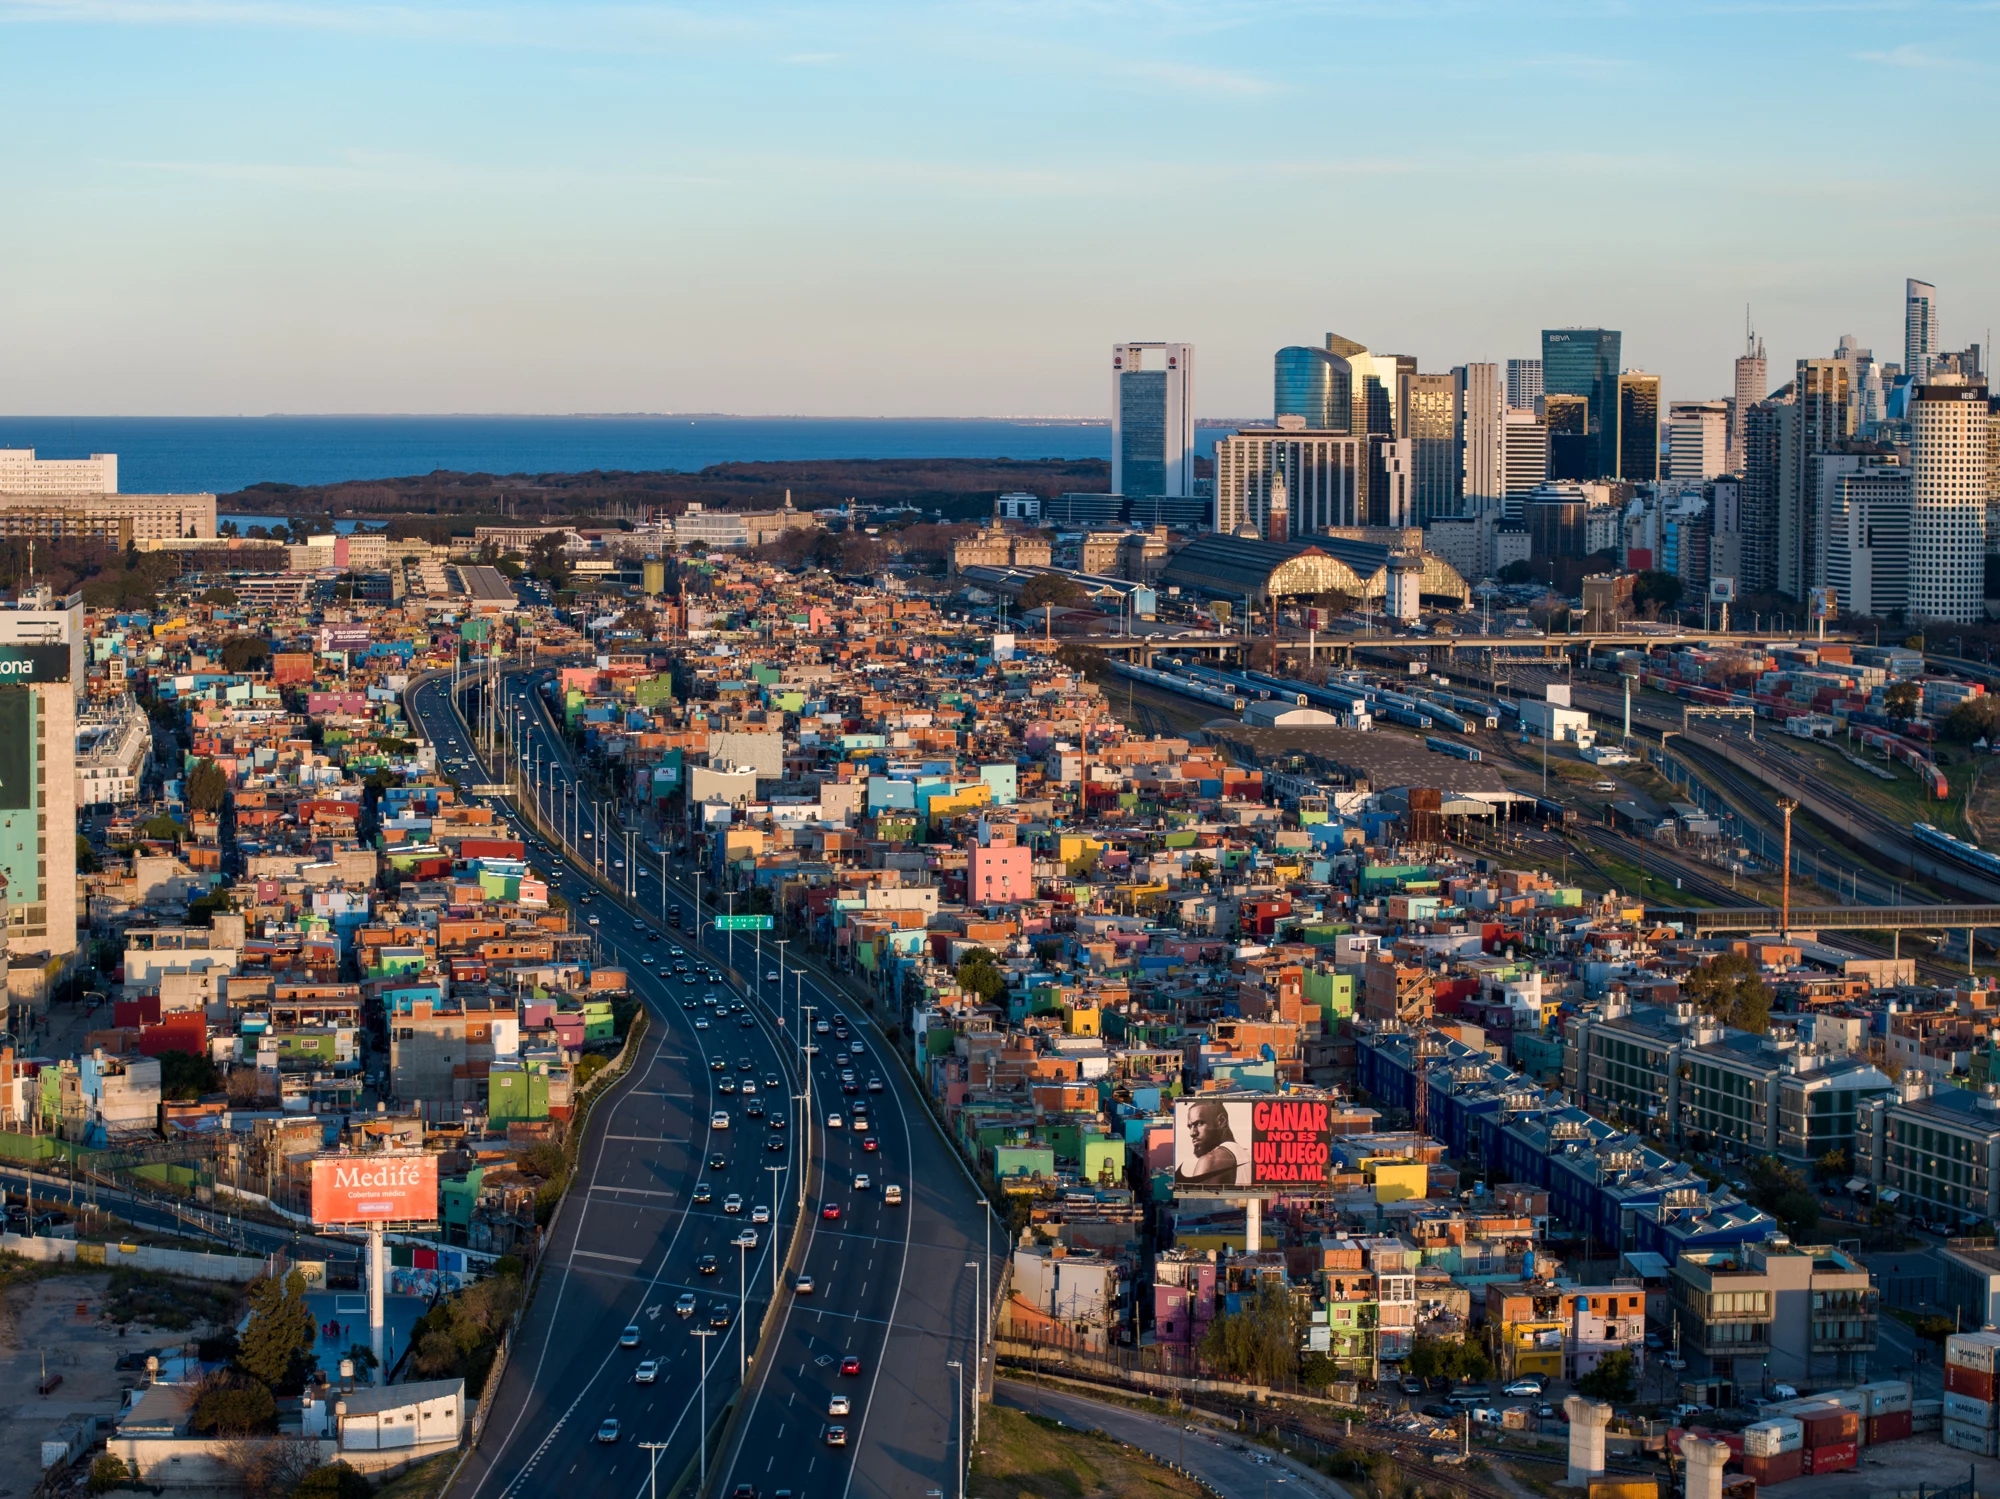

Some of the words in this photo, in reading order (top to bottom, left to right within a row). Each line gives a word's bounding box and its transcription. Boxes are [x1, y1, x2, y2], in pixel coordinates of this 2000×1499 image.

[1549, 334, 1571, 342] BBVA
[0, 660, 33, 675] ona
[1254, 1102, 1328, 1131] GANAR
[1267, 1131, 1295, 1141] NO
[1297, 1131, 1317, 1141] ES
[1253, 1142, 1277, 1163] UN
[1278, 1142, 1328, 1164] JUEGO
[334, 1165, 420, 1188] Medifé
[1255, 1164, 1299, 1180] PARA
[1300, 1164, 1328, 1181] MI.
[348, 1189, 380, 1199] Cobertura
[381, 1189, 406, 1197] médica
[1958, 1349, 1986, 1360] MAERSK
[1955, 1403, 1983, 1416] MAERSK
[1776, 1431, 1799, 1443] MAERSK
[1956, 1431, 1983, 1443] MAERSK
